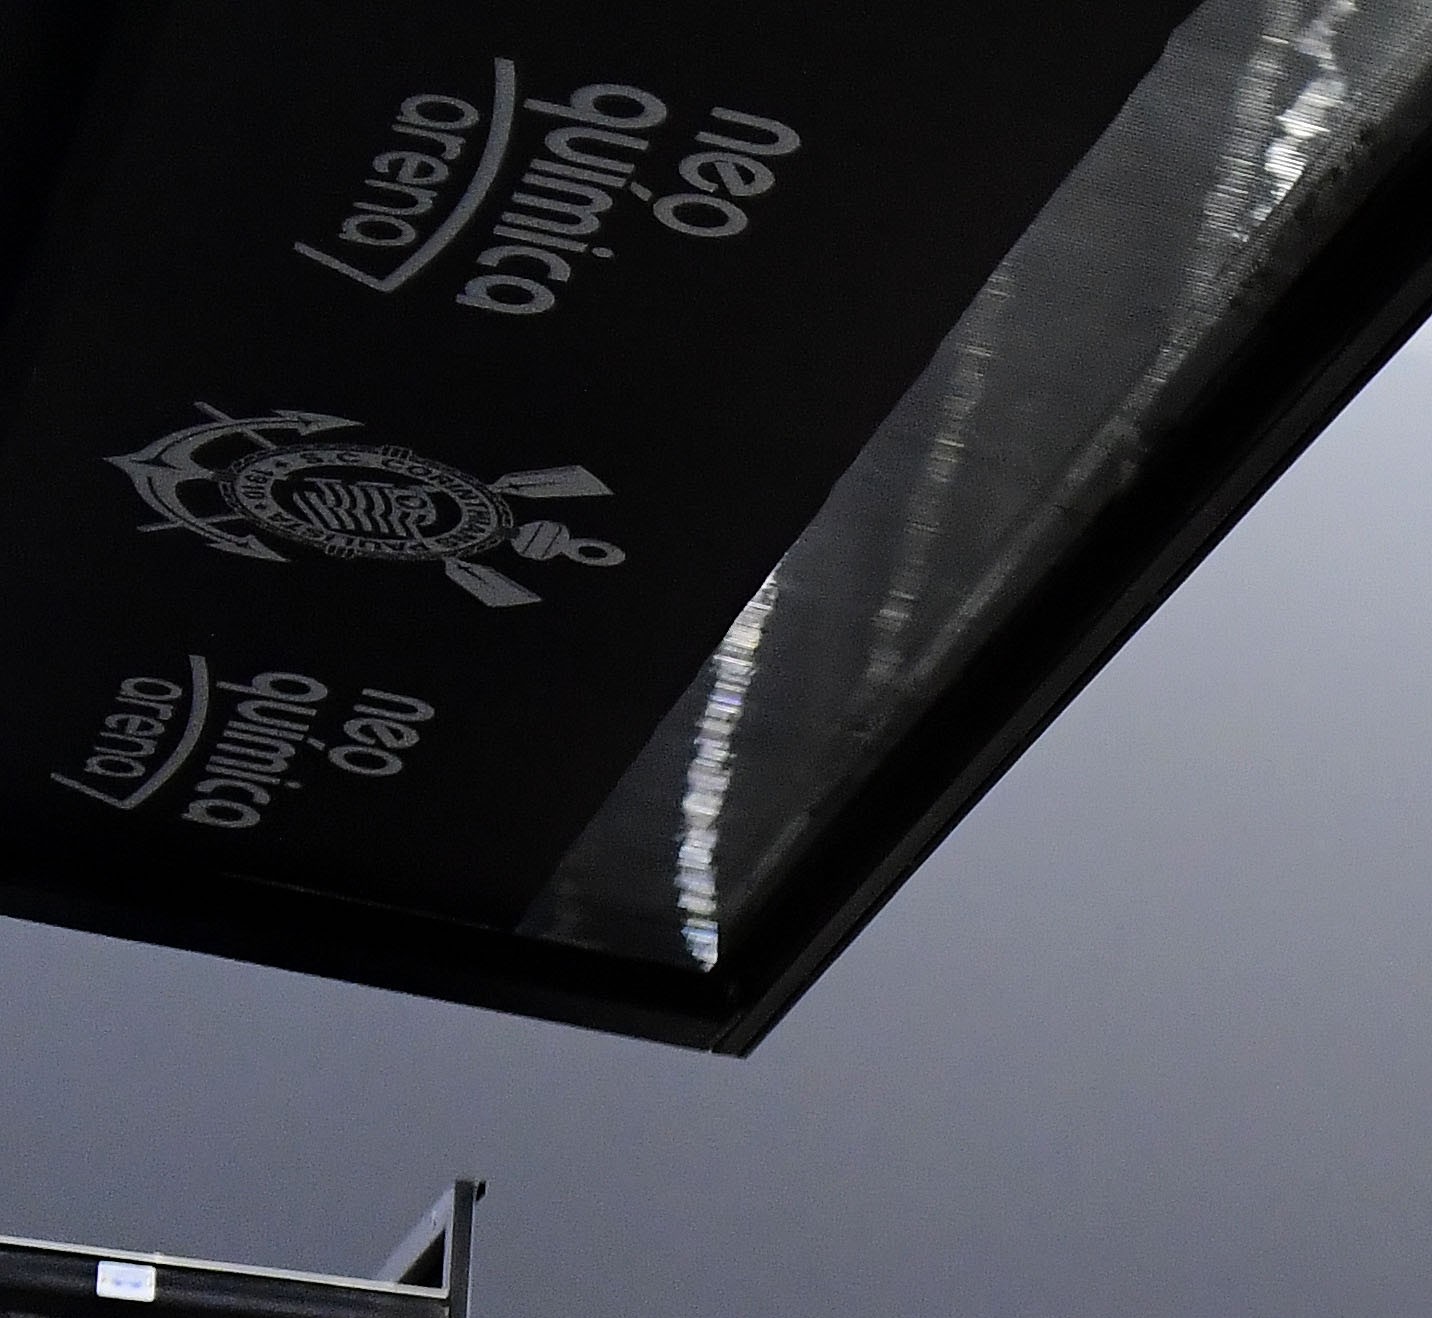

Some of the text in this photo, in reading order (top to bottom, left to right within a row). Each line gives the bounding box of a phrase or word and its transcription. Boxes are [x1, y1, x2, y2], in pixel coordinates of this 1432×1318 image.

[338, 93, 480, 247] arena
[456, 83, 668, 315] química
[653, 106, 802, 238] neo
[83, 676, 183, 778] arena
[181, 671, 329, 829] química
[328, 688, 436, 776] neo
